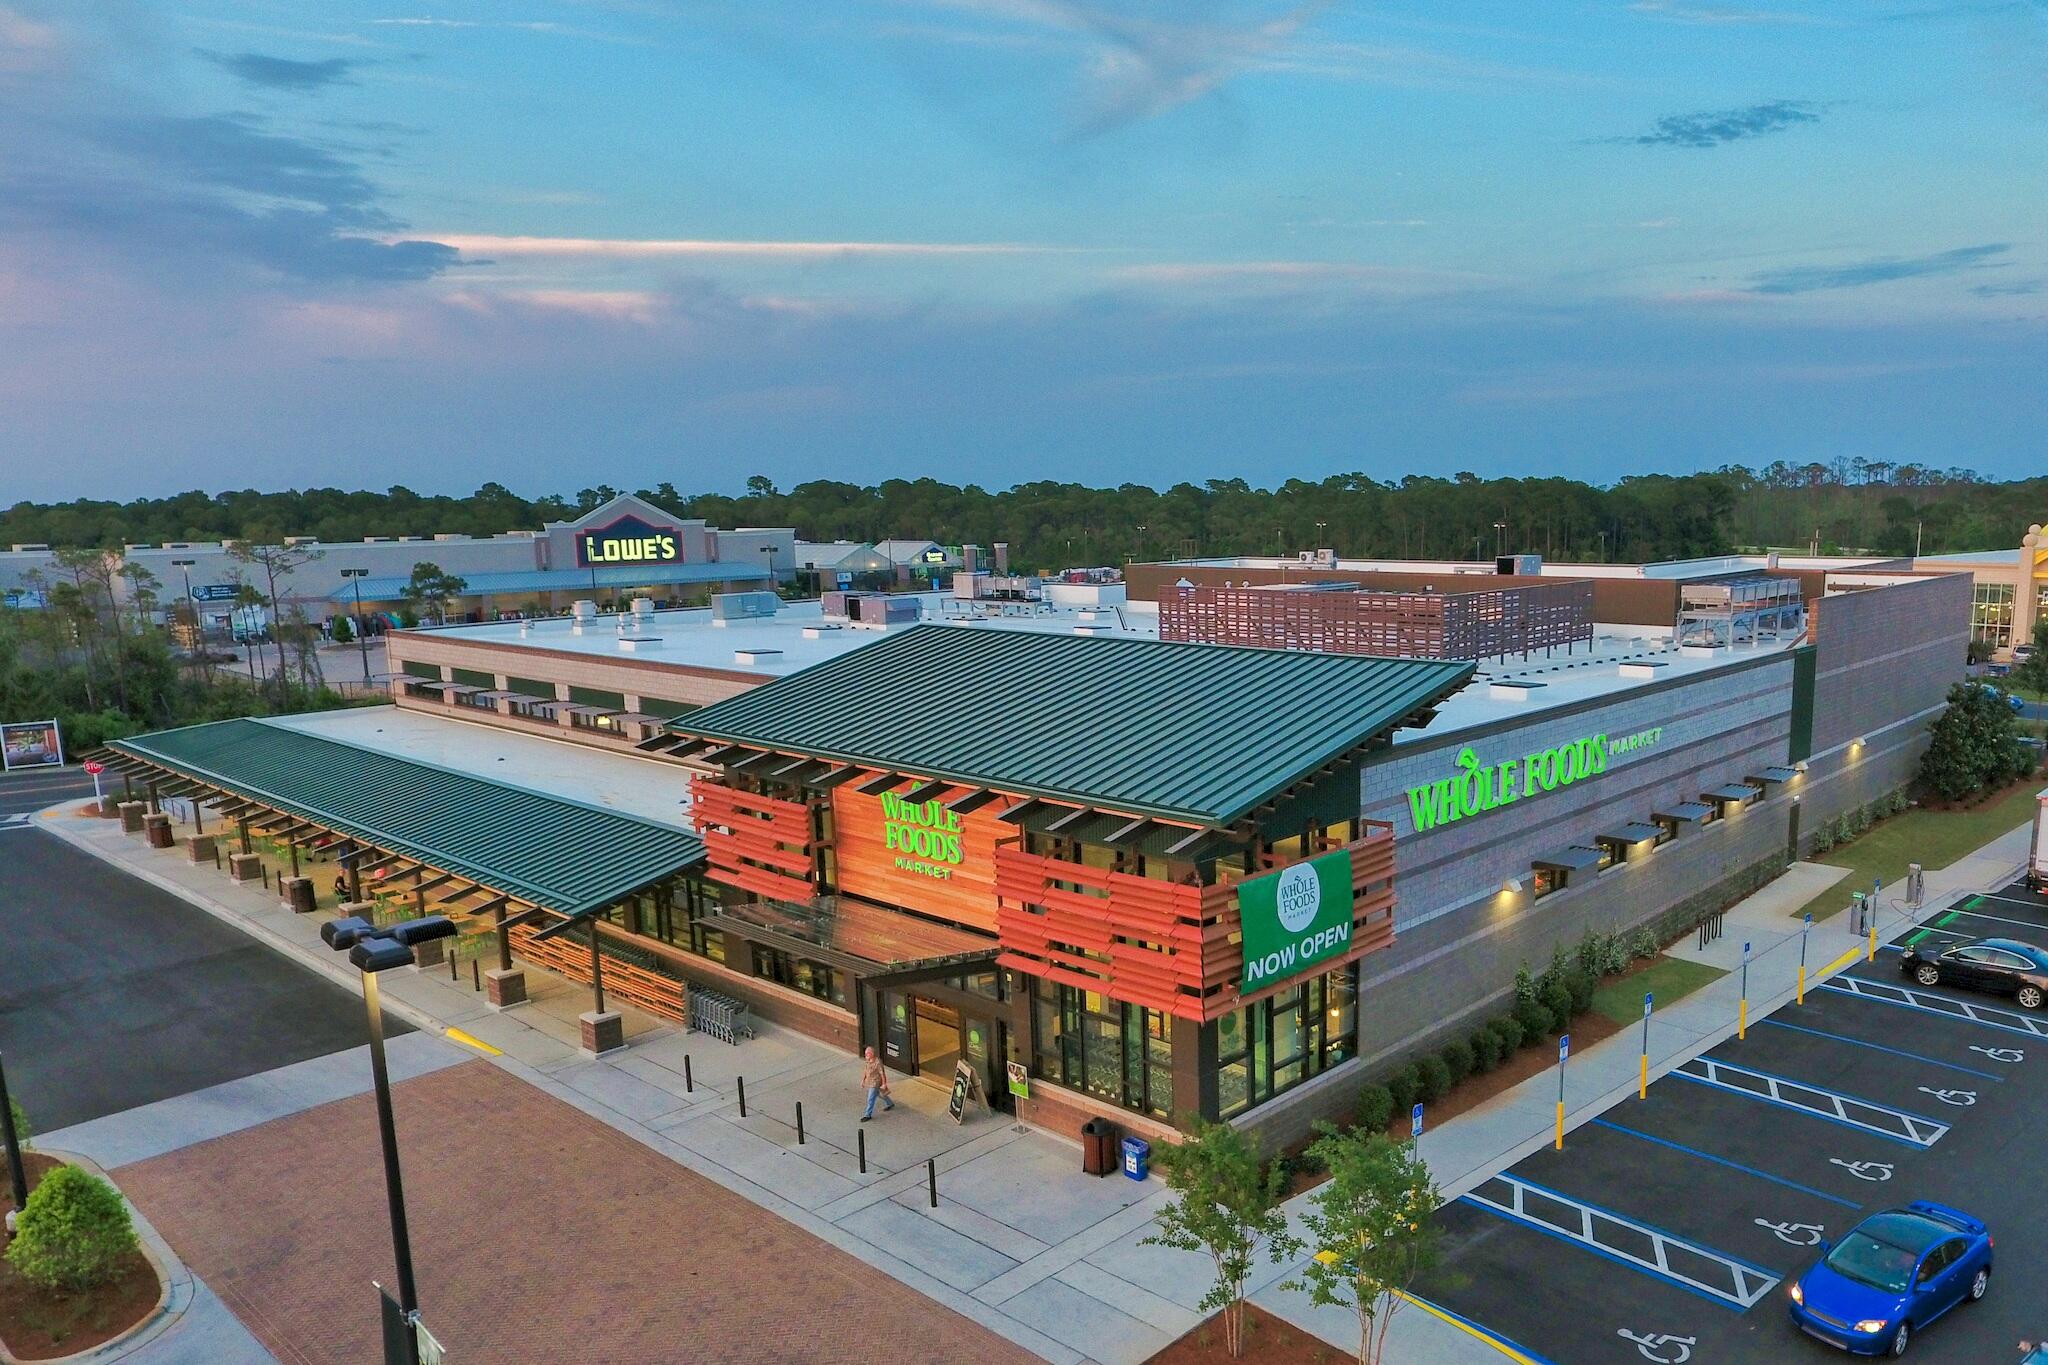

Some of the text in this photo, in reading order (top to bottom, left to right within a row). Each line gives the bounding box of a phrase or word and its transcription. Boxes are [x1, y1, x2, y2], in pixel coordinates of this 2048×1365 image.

[586, 535, 675, 562] LOWE'S
[1404, 728, 1662, 832] WHOLE FOODS MARKET
[881, 791, 964, 833] WHOLE
[885, 822, 964, 865] FOODS
[895, 858, 951, 880] MARKET
[1281, 877, 1315, 899] WHOLE
[1283, 891, 1315, 913] FOODS
[1248, 922, 1349, 981] NOW OPEN
